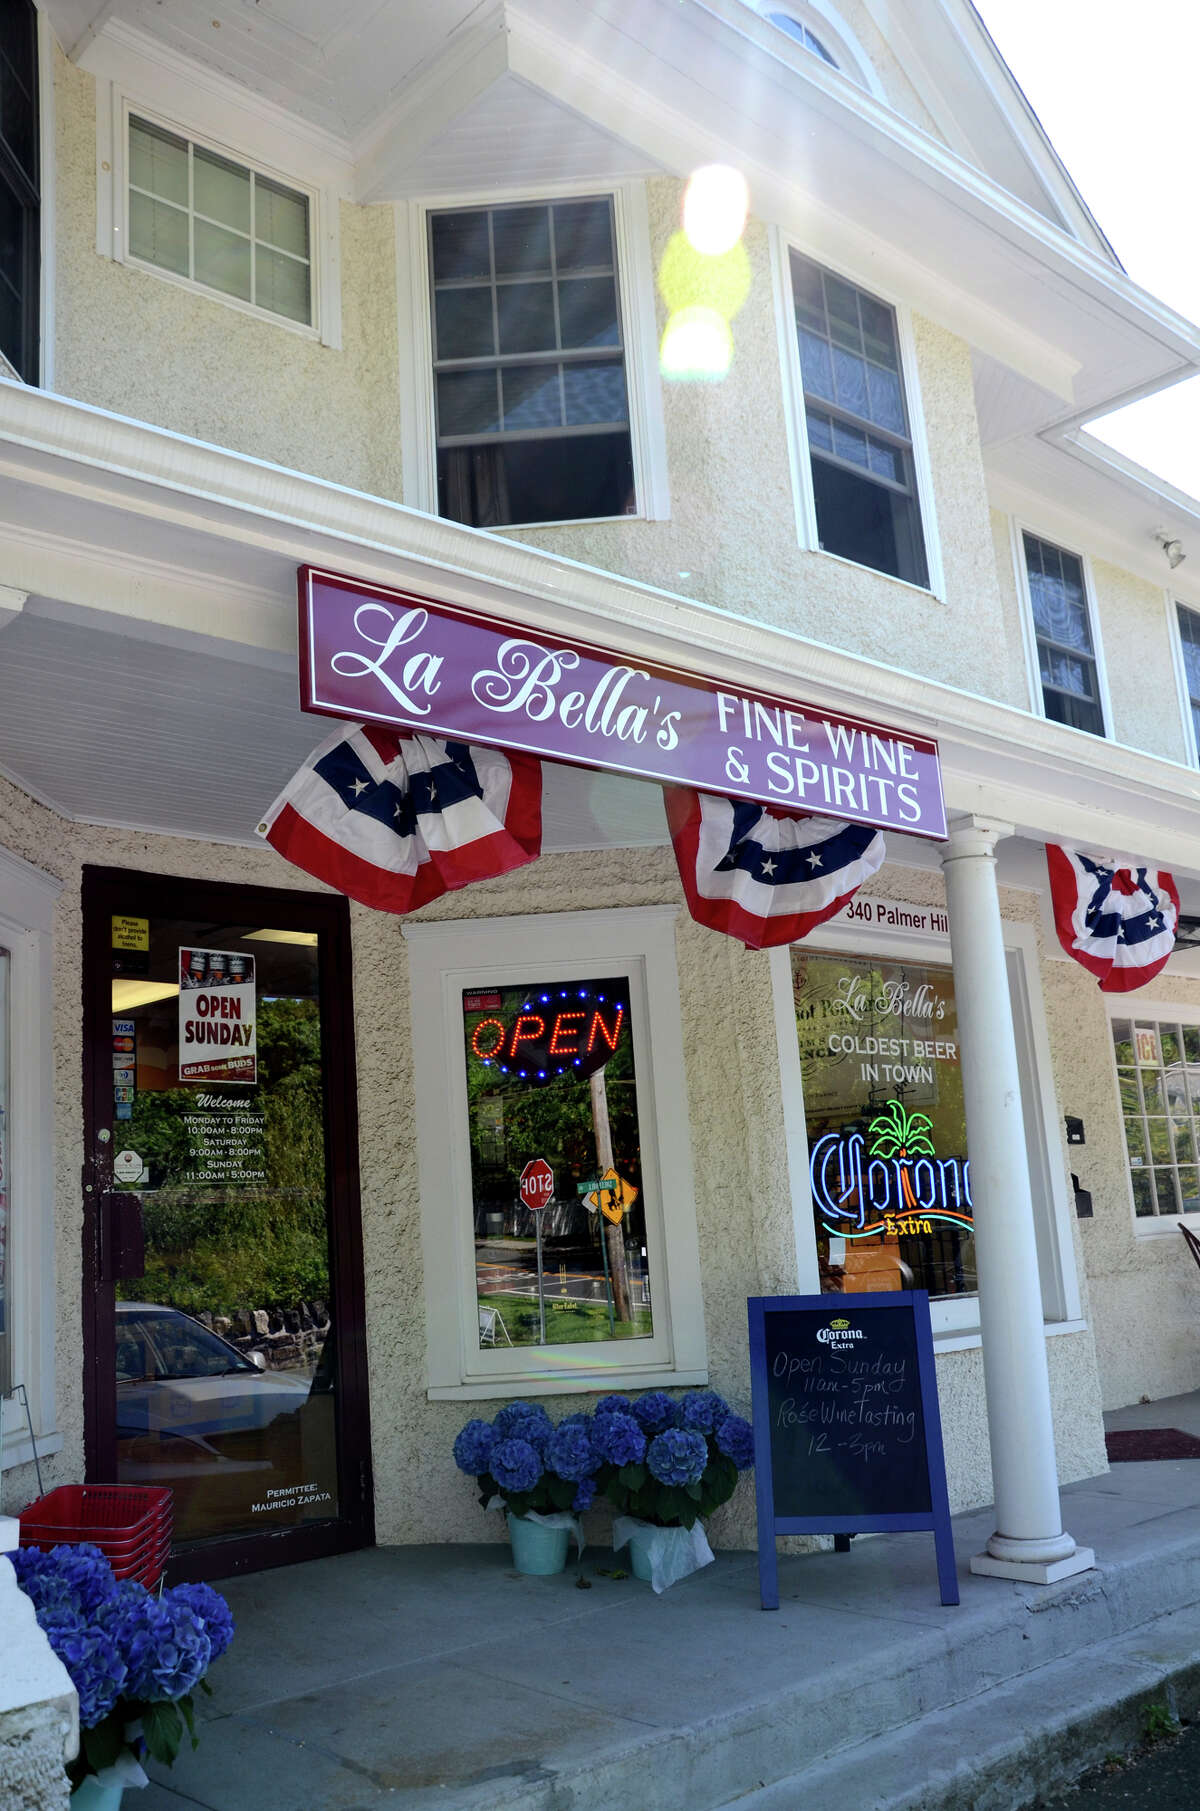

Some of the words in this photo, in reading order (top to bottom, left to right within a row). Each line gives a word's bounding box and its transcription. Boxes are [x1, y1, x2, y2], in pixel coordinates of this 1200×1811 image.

[330, 602, 443, 716] La
[470, 638, 682, 752] Bella's
[716, 691, 809, 752] FINE
[823, 720, 920, 781] WINE
[725, 747, 751, 785] &
[768, 751, 922, 822] SPIRITS
[846, 901, 872, 921] 340
[876, 904, 926, 928] Palmer
[930, 913, 948, 933] Hil
[196, 994, 241, 1020] OPEN
[833, 975, 866, 1021] La
[875, 981, 945, 1020] Bella's
[114, 1024, 134, 1032] VISA
[185, 1020, 253, 1046] SUNDAY
[471, 1009, 624, 1059] OPEN
[829, 1034, 911, 1059] COLDEST
[914, 1040, 957, 1060] BEER
[183, 1064, 211, 1076] GRAB
[227, 1058, 253, 1070] BUDS
[861, 1063, 879, 1082] IN
[882, 1064, 933, 1084] TOWN
[196, 1094, 251, 1108] Welcome
[184, 1116, 221, 1124] MONDAY
[235, 1116, 265, 1124] FRIDAY
[188, 1126, 225, 1134] 10:00AM
[230, 1126, 263, 1134] 8:00PM
[189, 1148, 223, 1156] 9:00AM
[228, 1148, 261, 1156] 8:00PM
[203, 1138, 247, 1146] SATURDAY
[207, 1160, 242, 1168] SUNDAY
[186, 1171, 225, 1180] 11:00AM
[231, 1170, 265, 1179] 5:00PM
[884, 1213, 933, 1235] Extra
[816, 1328, 863, 1344] Corona
[831, 1341, 854, 1349] Extra
[773, 1351, 822, 1386] Open
[830, 1350, 906, 1392] Sunday
[821, 1400, 856, 1424] Wine
[854, 1399, 915, 1442] Tasting
[251, 1498, 296, 1513] MAURICIO
[298, 1492, 332, 1505] ZAPATA
